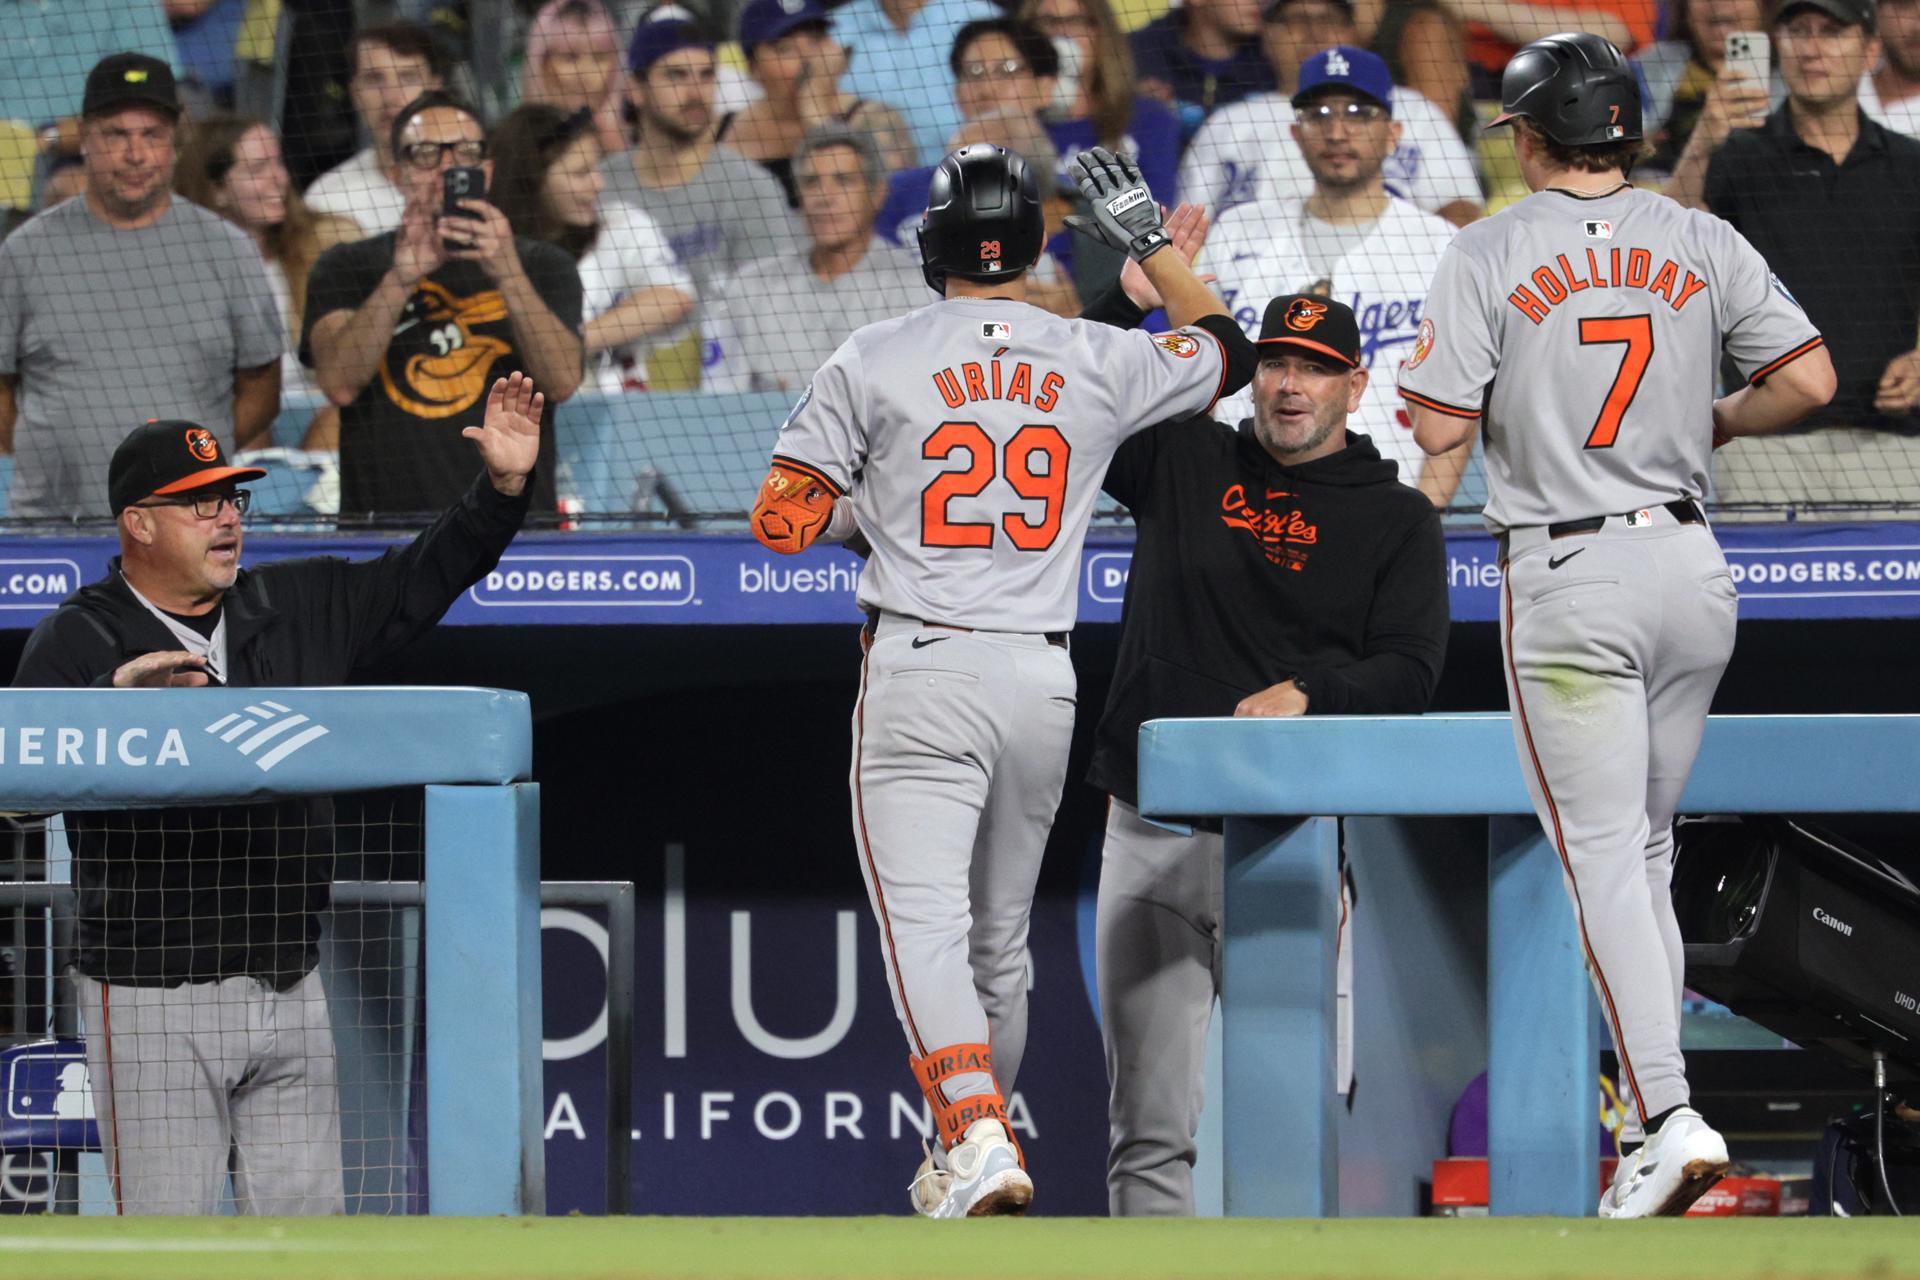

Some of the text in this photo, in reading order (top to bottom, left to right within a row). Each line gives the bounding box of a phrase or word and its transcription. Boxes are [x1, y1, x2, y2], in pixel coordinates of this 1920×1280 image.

[1609, 105, 1620, 124] 7
[1111, 190, 1146, 215] Franklin
[980, 240, 1001, 259] 29
[1507, 247, 1707, 326] HOLLIDAY
[932, 347, 1065, 413] URÍAS
[1578, 313, 1654, 450] 7
[768, 470, 789, 493] 29
[920, 421, 1072, 552] 29
[486, 570, 682, 591] DODGERS.COM
[739, 561, 858, 593] blueshi
[1104, 567, 1129, 588] D
[1446, 556, 1501, 588] hie
[1729, 560, 1920, 584] DODGERS.COM
[0, 727, 190, 767] ERICA
[1812, 907, 1853, 937] Canon
[1894, 990, 1916, 1010] UHD
[926, 1050, 993, 1082] URÍAS
[543, 1091, 1039, 1140] AIFORNA
[946, 1100, 1010, 1133] URÍAS
